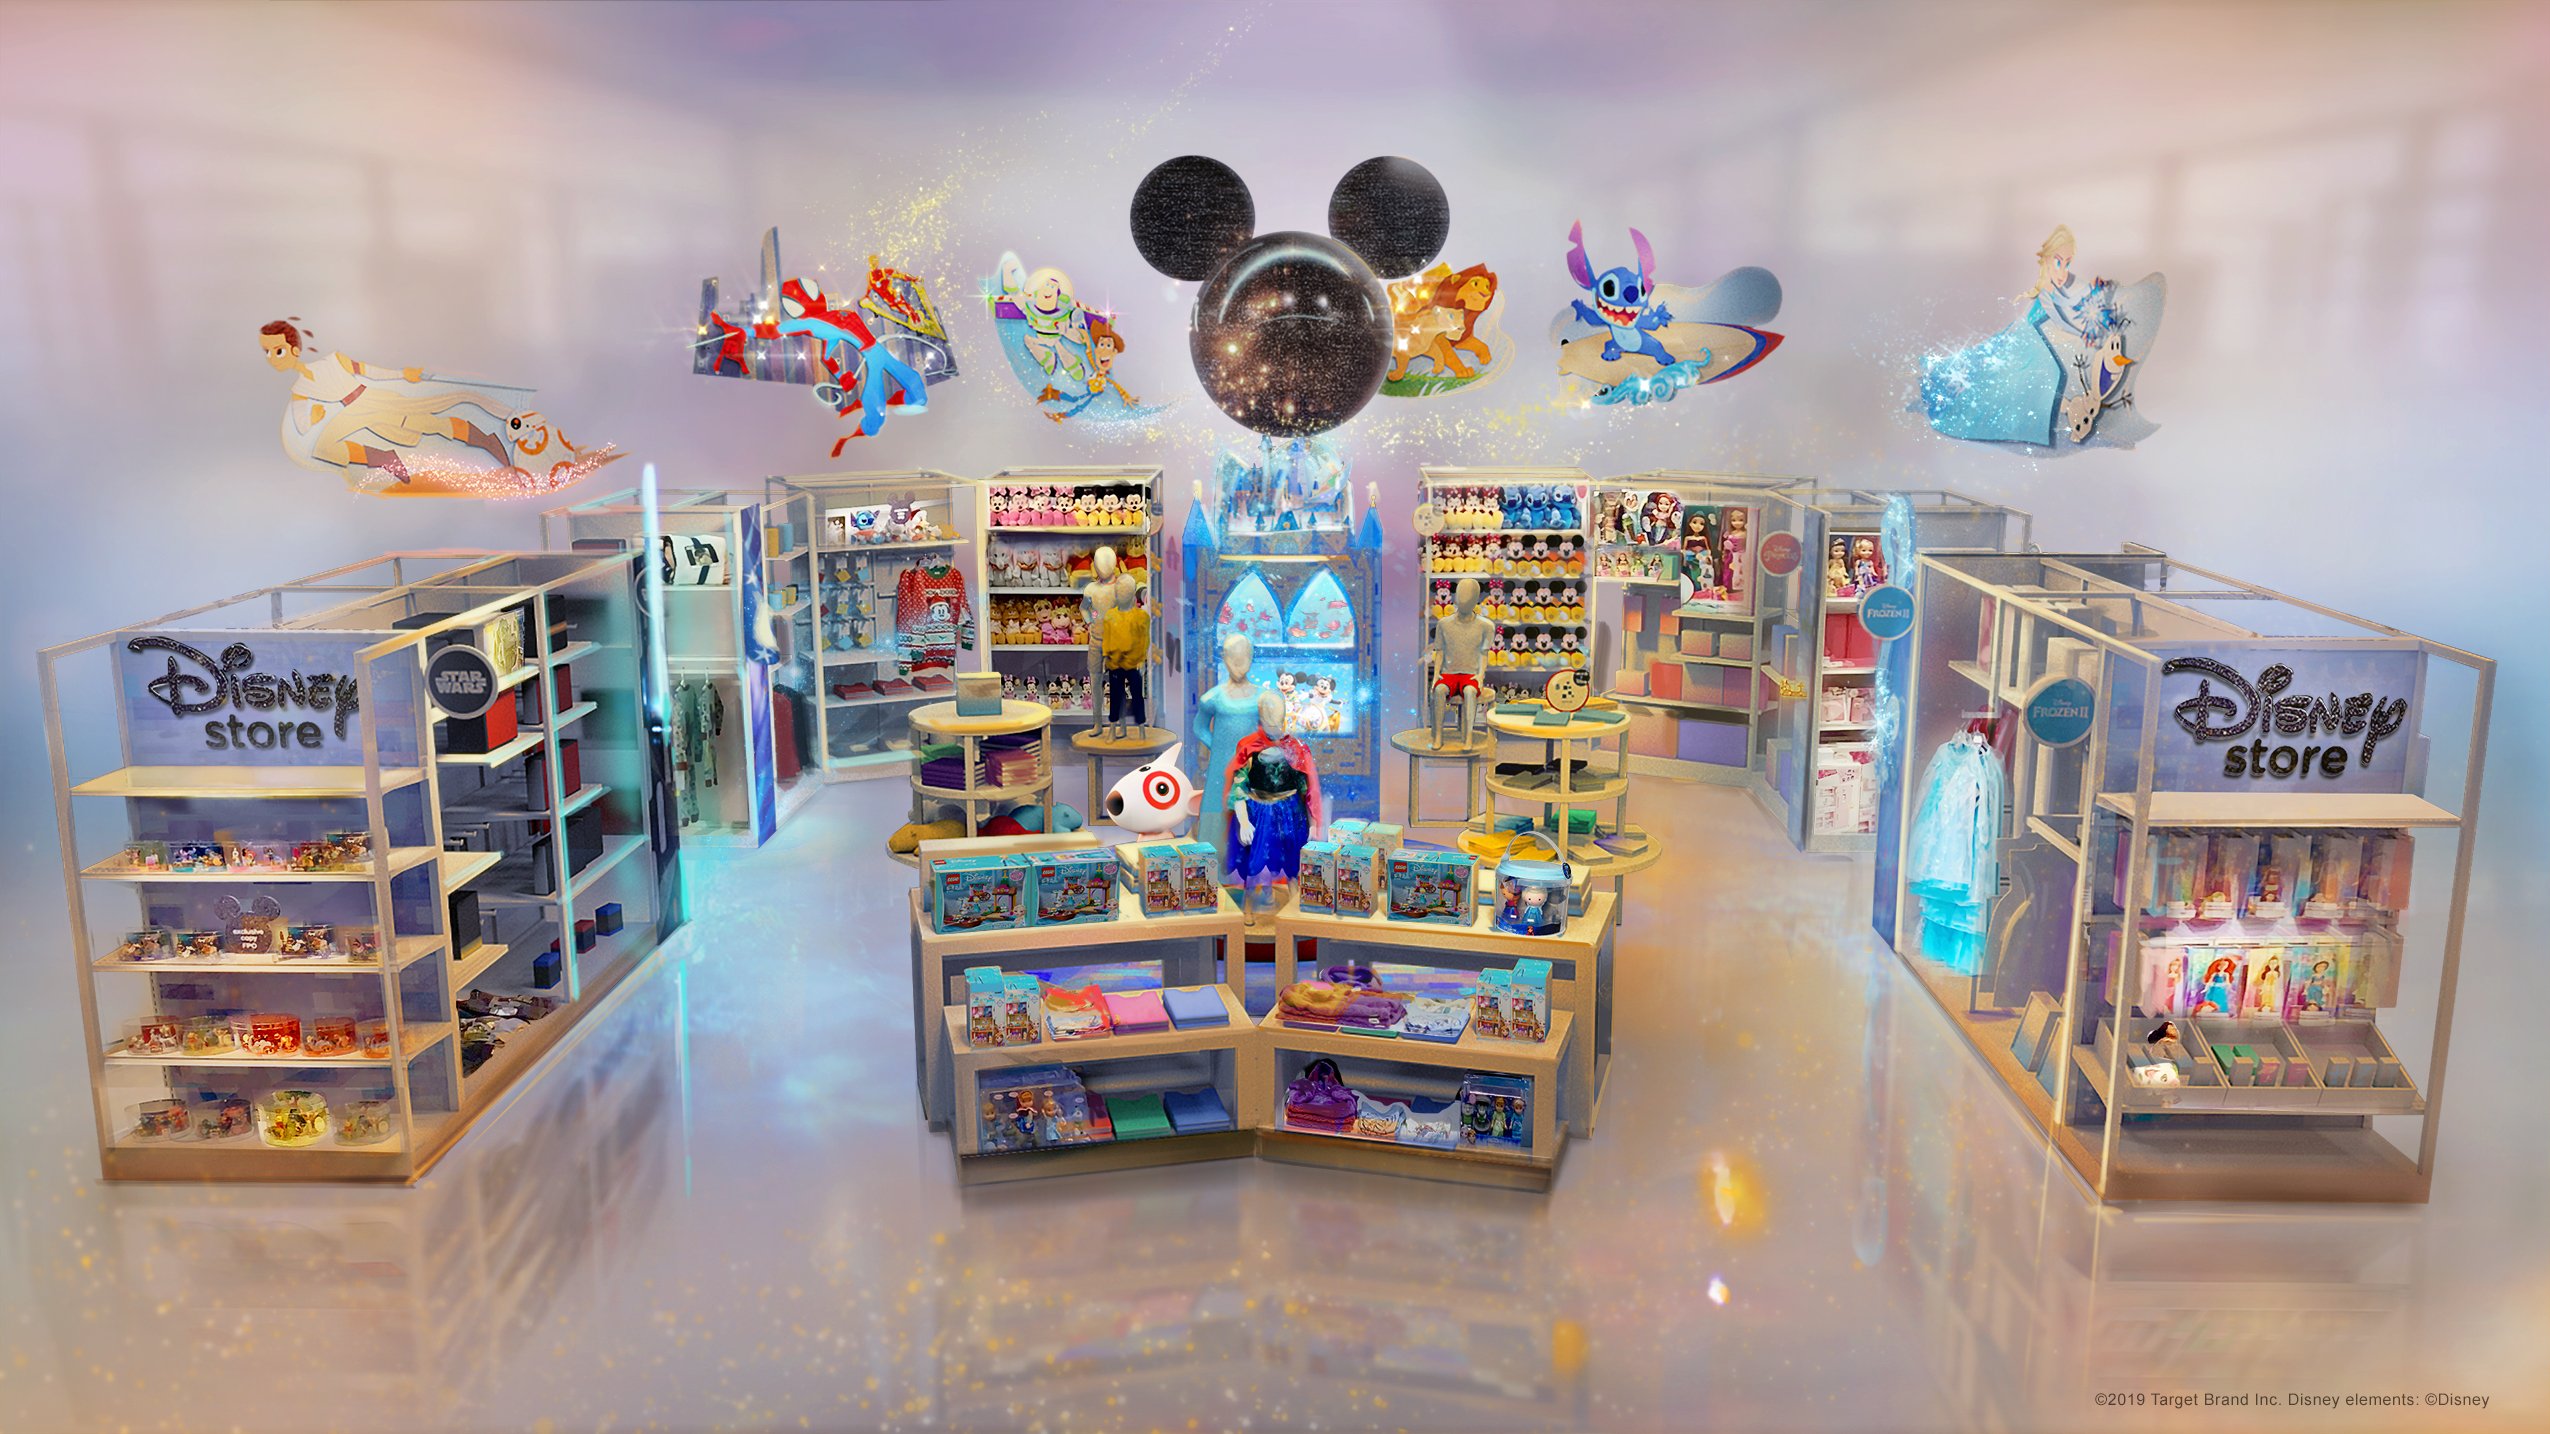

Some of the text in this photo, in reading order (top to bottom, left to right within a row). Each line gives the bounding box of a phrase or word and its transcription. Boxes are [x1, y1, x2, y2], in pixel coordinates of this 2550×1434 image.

[1867, 608, 1902, 618] FROZEN
[128, 636, 360, 738] Disney
[436, 671, 487, 682] STAR
[436, 680, 487, 694] WARS
[2033, 706, 2078, 718] FROZEN
[2162, 657, 2408, 767] Disney
[205, 714, 323, 749] store
[2223, 738, 2349, 777] store
